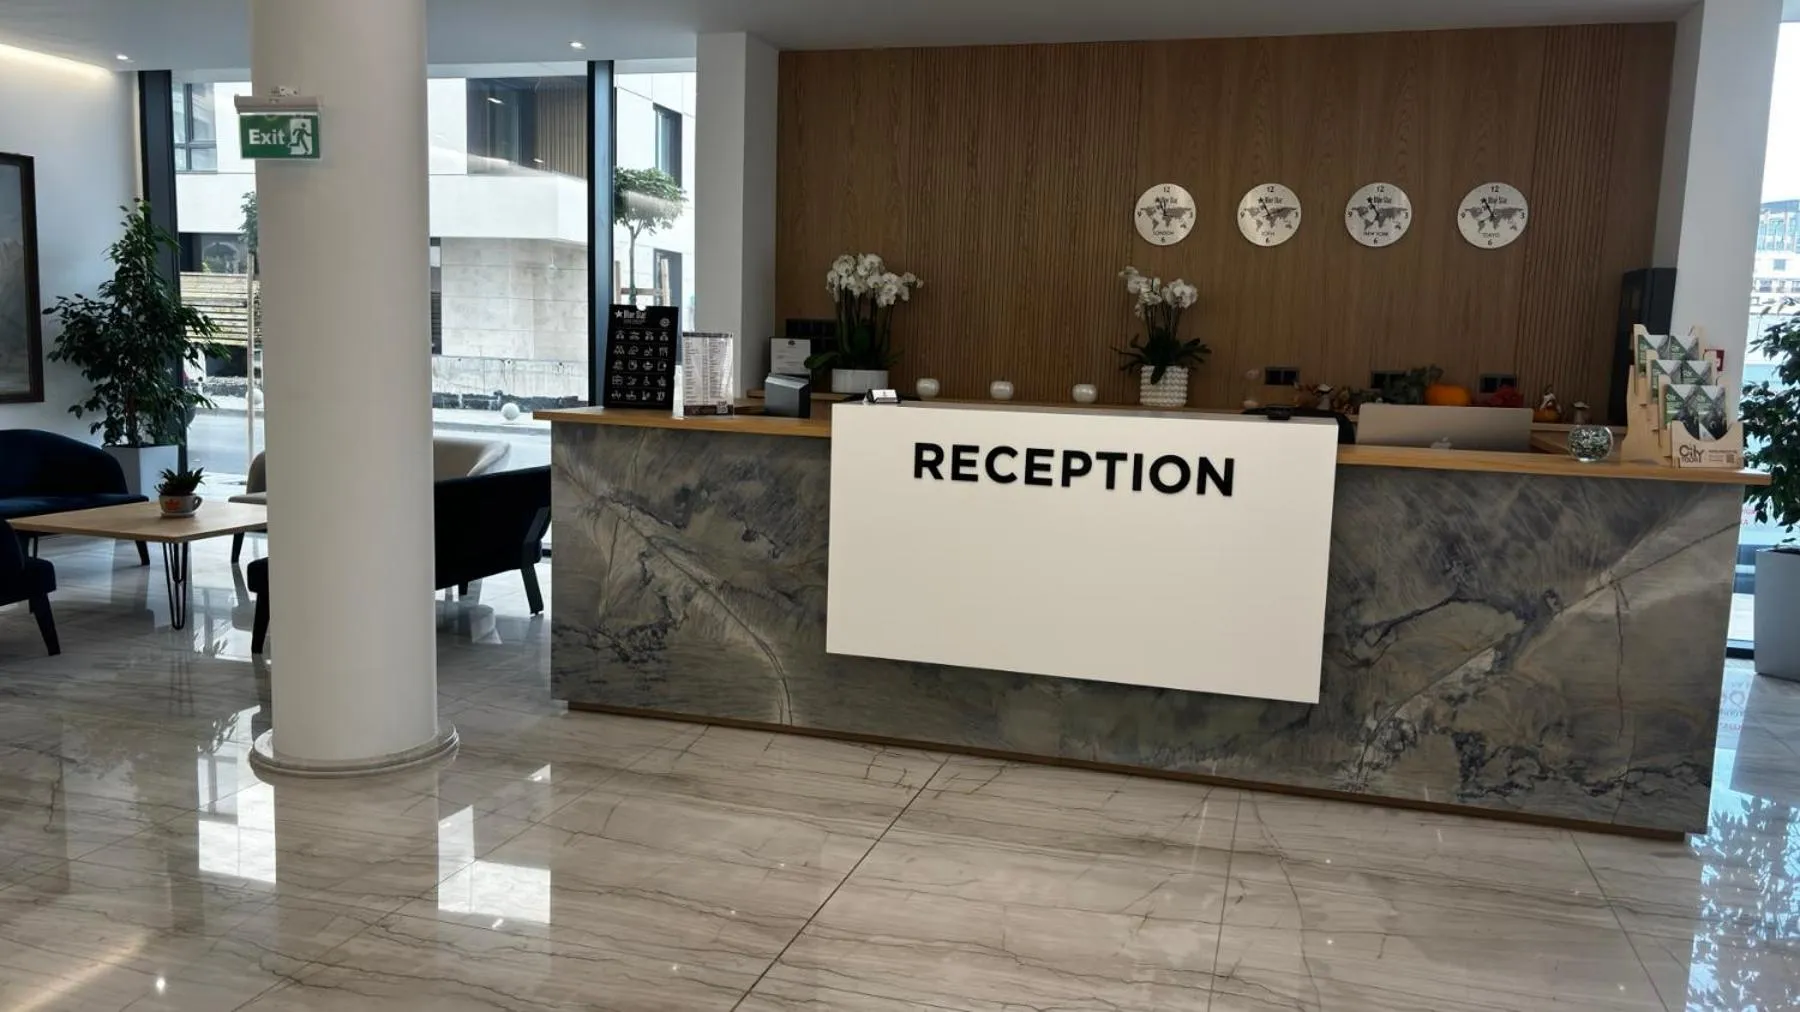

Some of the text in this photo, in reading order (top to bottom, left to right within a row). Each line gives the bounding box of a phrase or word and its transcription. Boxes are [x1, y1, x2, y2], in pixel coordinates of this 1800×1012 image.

[248, 128, 285, 145] Exit
[1679, 444, 1705, 462] City
[913, 442, 1235, 497] RECEPTION
